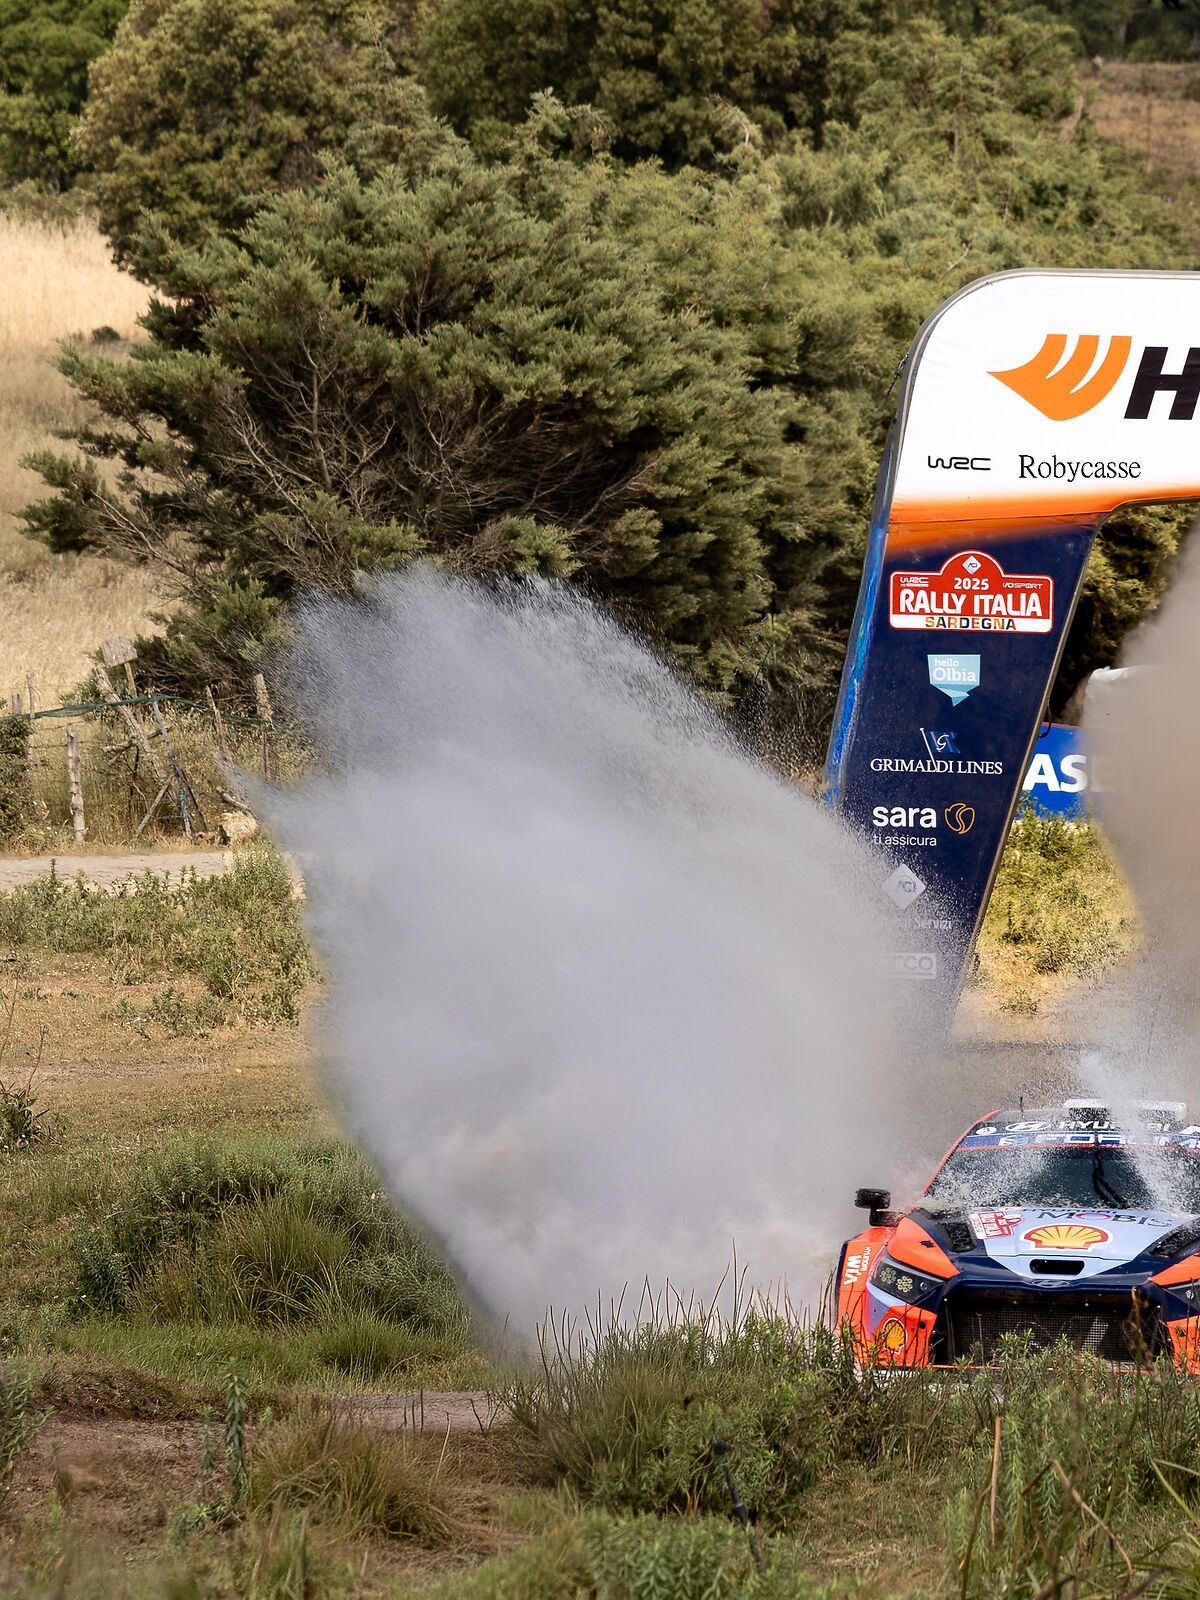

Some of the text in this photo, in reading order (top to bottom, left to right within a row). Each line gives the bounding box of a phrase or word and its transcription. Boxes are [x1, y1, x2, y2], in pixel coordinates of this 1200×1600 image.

[927, 455, 991, 471] WRC
[1018, 454, 1142, 483] Robycasse
[953, 577, 990, 591] 2025
[899, 588, 1043, 617] RALLY ITALIA
[925, 616, 1017, 631] SARDEGNA
[934, 657, 960, 667] hello
[932, 667, 977, 682] Olbia
[870, 758, 1003, 775] GRIMALDI LINES
[872, 806, 937, 828] sara
[873, 833, 937, 846] ti assicura
[1036, 1211, 1173, 1228] MOBIS
